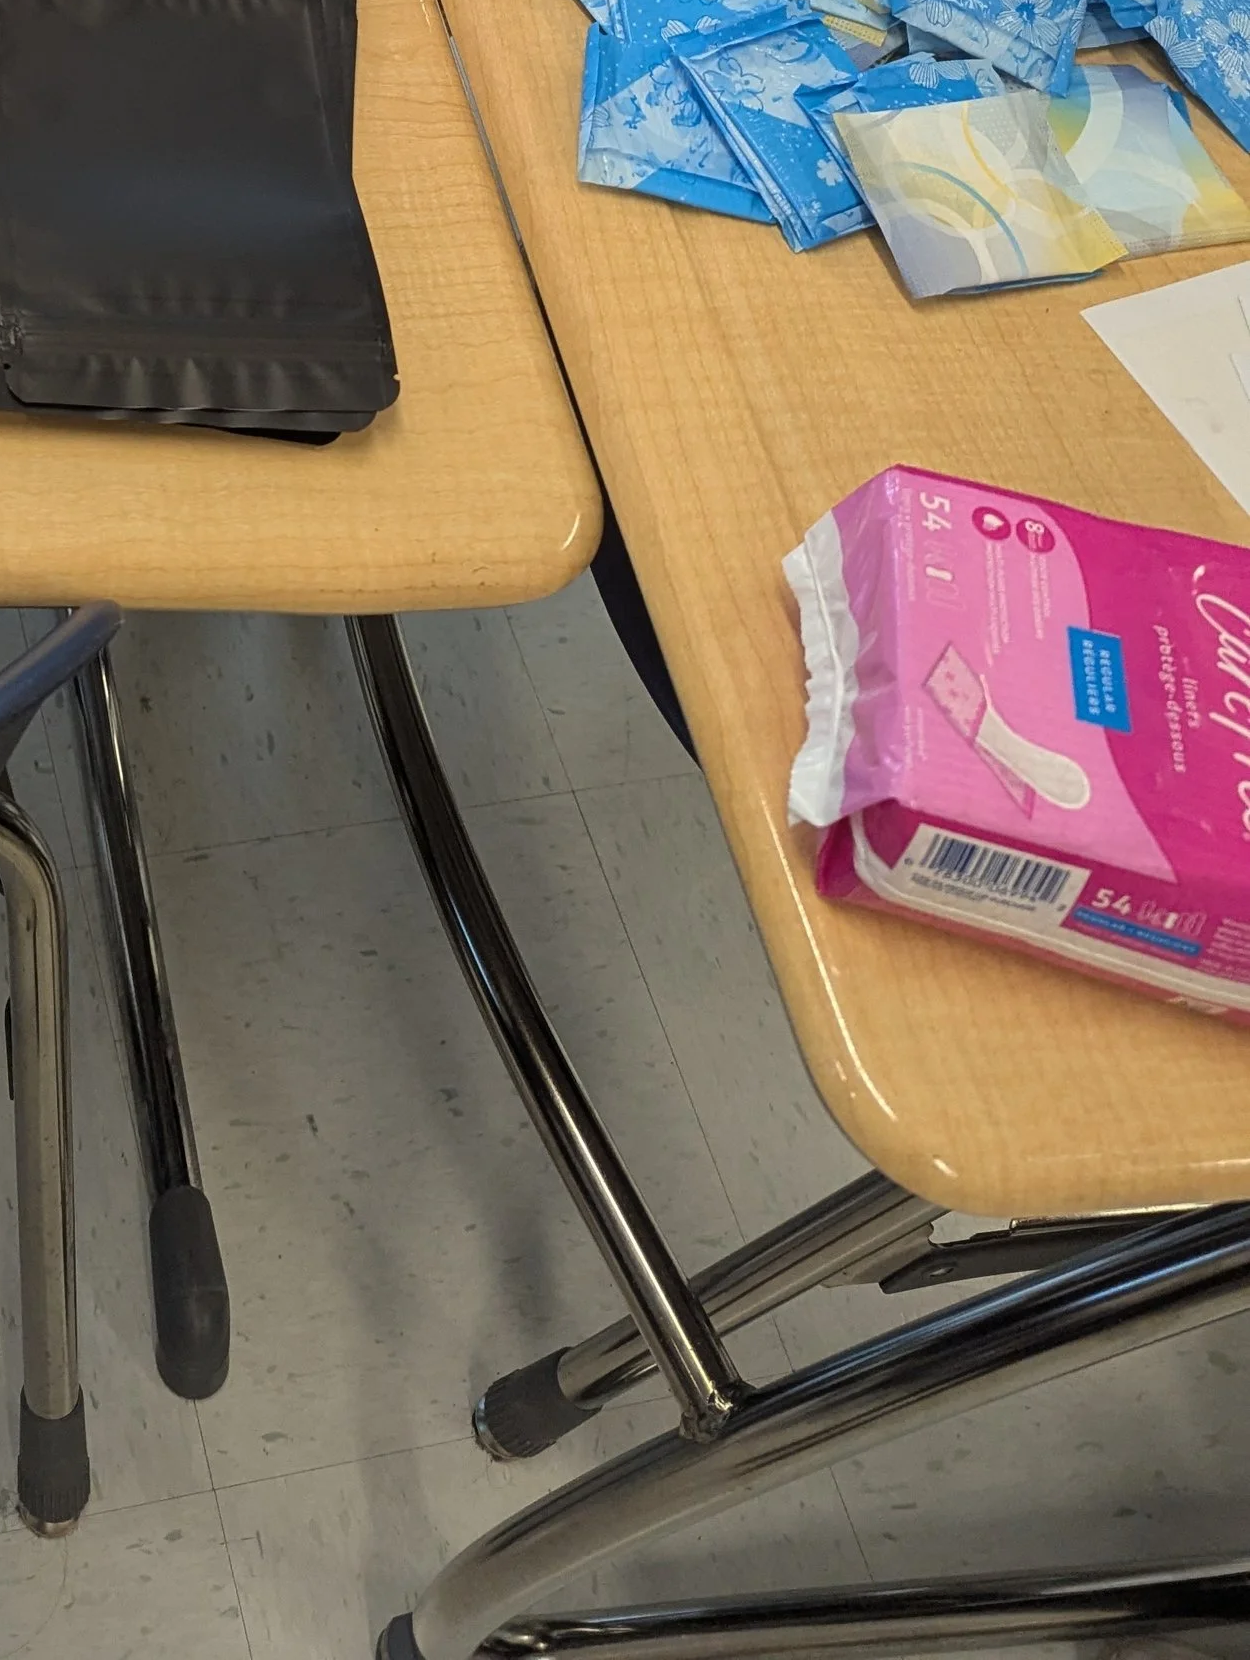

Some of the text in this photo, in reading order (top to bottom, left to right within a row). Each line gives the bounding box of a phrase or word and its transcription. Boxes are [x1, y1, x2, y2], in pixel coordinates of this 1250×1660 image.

[920, 491, 952, 533] 54
[1100, 648, 1116, 714] REGULAR
[1153, 624, 1187, 773] protège-dessous
[1182, 677, 1201, 729] liners
[1091, 888, 1132, 916] 54
